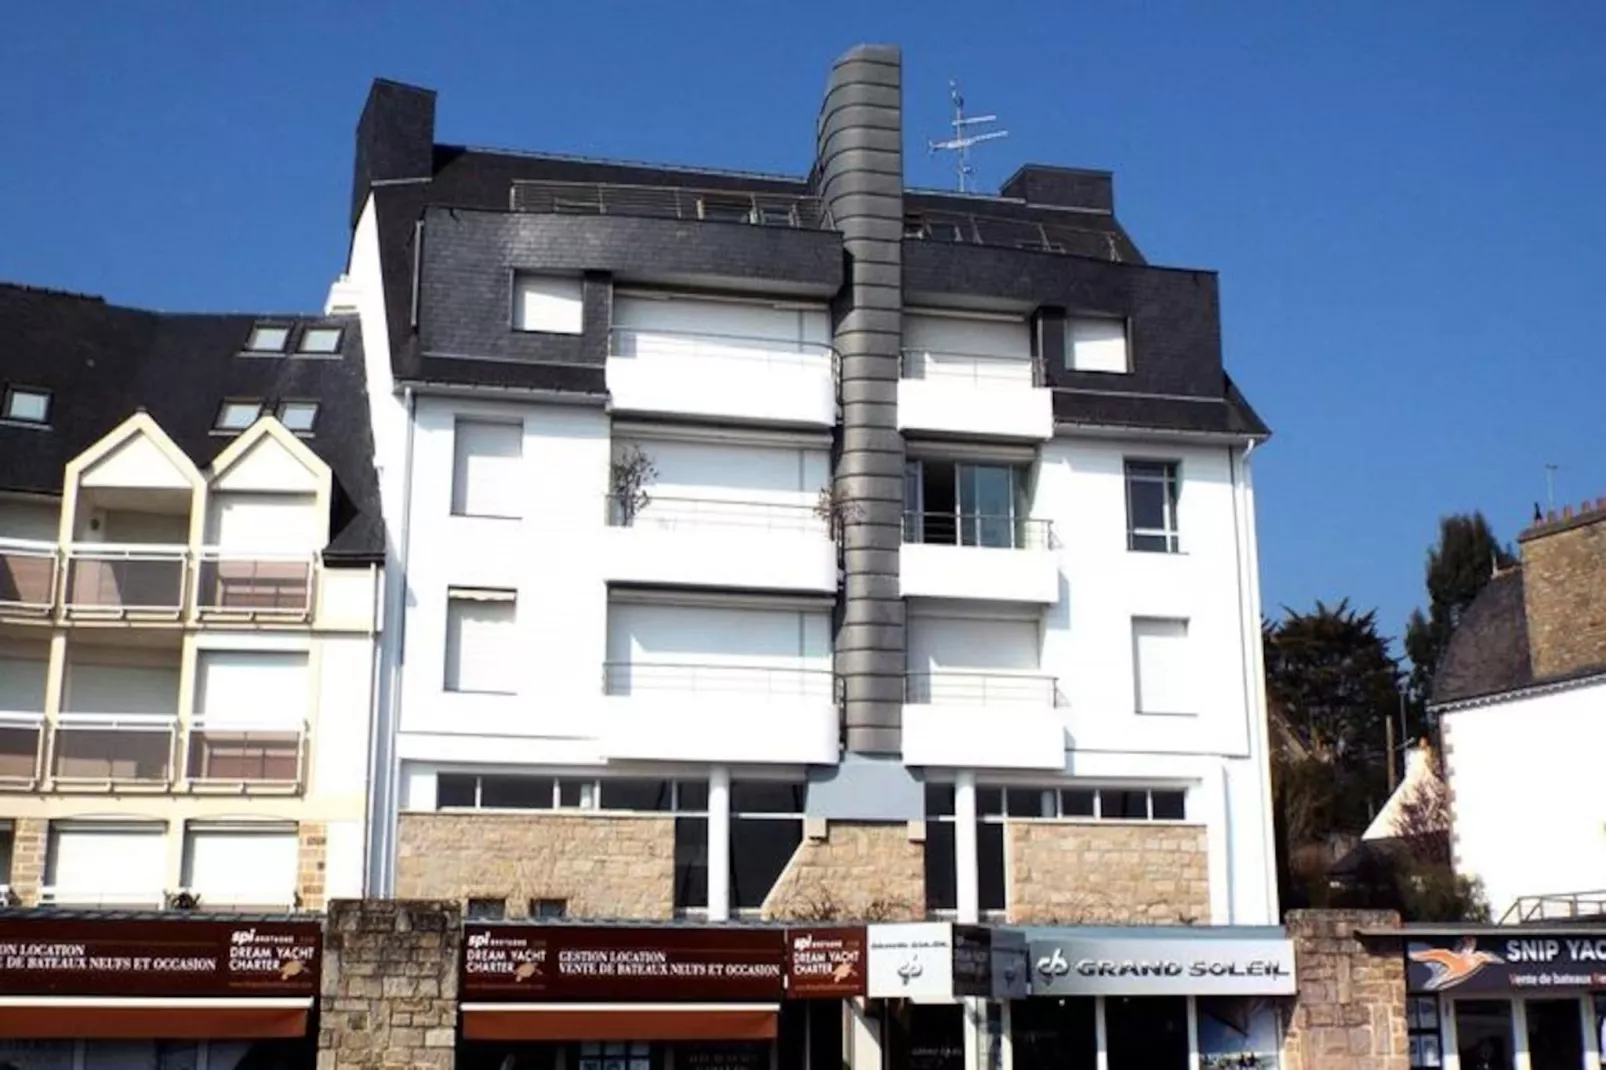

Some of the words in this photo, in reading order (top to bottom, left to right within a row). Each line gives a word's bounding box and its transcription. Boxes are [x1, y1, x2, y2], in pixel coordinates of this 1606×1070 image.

[19, 943, 85, 956] LOCATION
[229, 946, 272, 958] DREAM
[276, 946, 315, 959] YACHT
[466, 950, 507, 961] DREAM
[511, 950, 547, 962] YACHT
[1506, 939, 1560, 962] SNIP
[558, 951, 608, 962] GESTION
[610, 951, 666, 963] LOCATION
[793, 951, 826, 963] DREAM
[829, 950, 860, 962] YACHT
[6, 956, 25, 969] DE
[27, 956, 87, 970] BATEAUX
[89, 957, 132, 970] NEUFS
[133, 958, 151, 971] ET
[153, 958, 217, 971] OCCASION
[228, 959, 280, 971] CHARTER
[466, 961, 515, 973] CHARTER
[559, 962, 597, 974] VENTE
[599, 962, 616, 974] DE
[617, 962, 668, 975] BATEAUX
[670, 963, 706, 975] NEUFS
[708, 964, 723, 975] ET
[725, 964, 780, 976] OCCASION
[793, 963, 833, 975] CHARTER
[1077, 960, 1183, 977] GRAND
[1189, 960, 1291, 980] SOLEIL
[1538, 972, 1551, 985] de
[1552, 972, 1592, 985] bateaux
